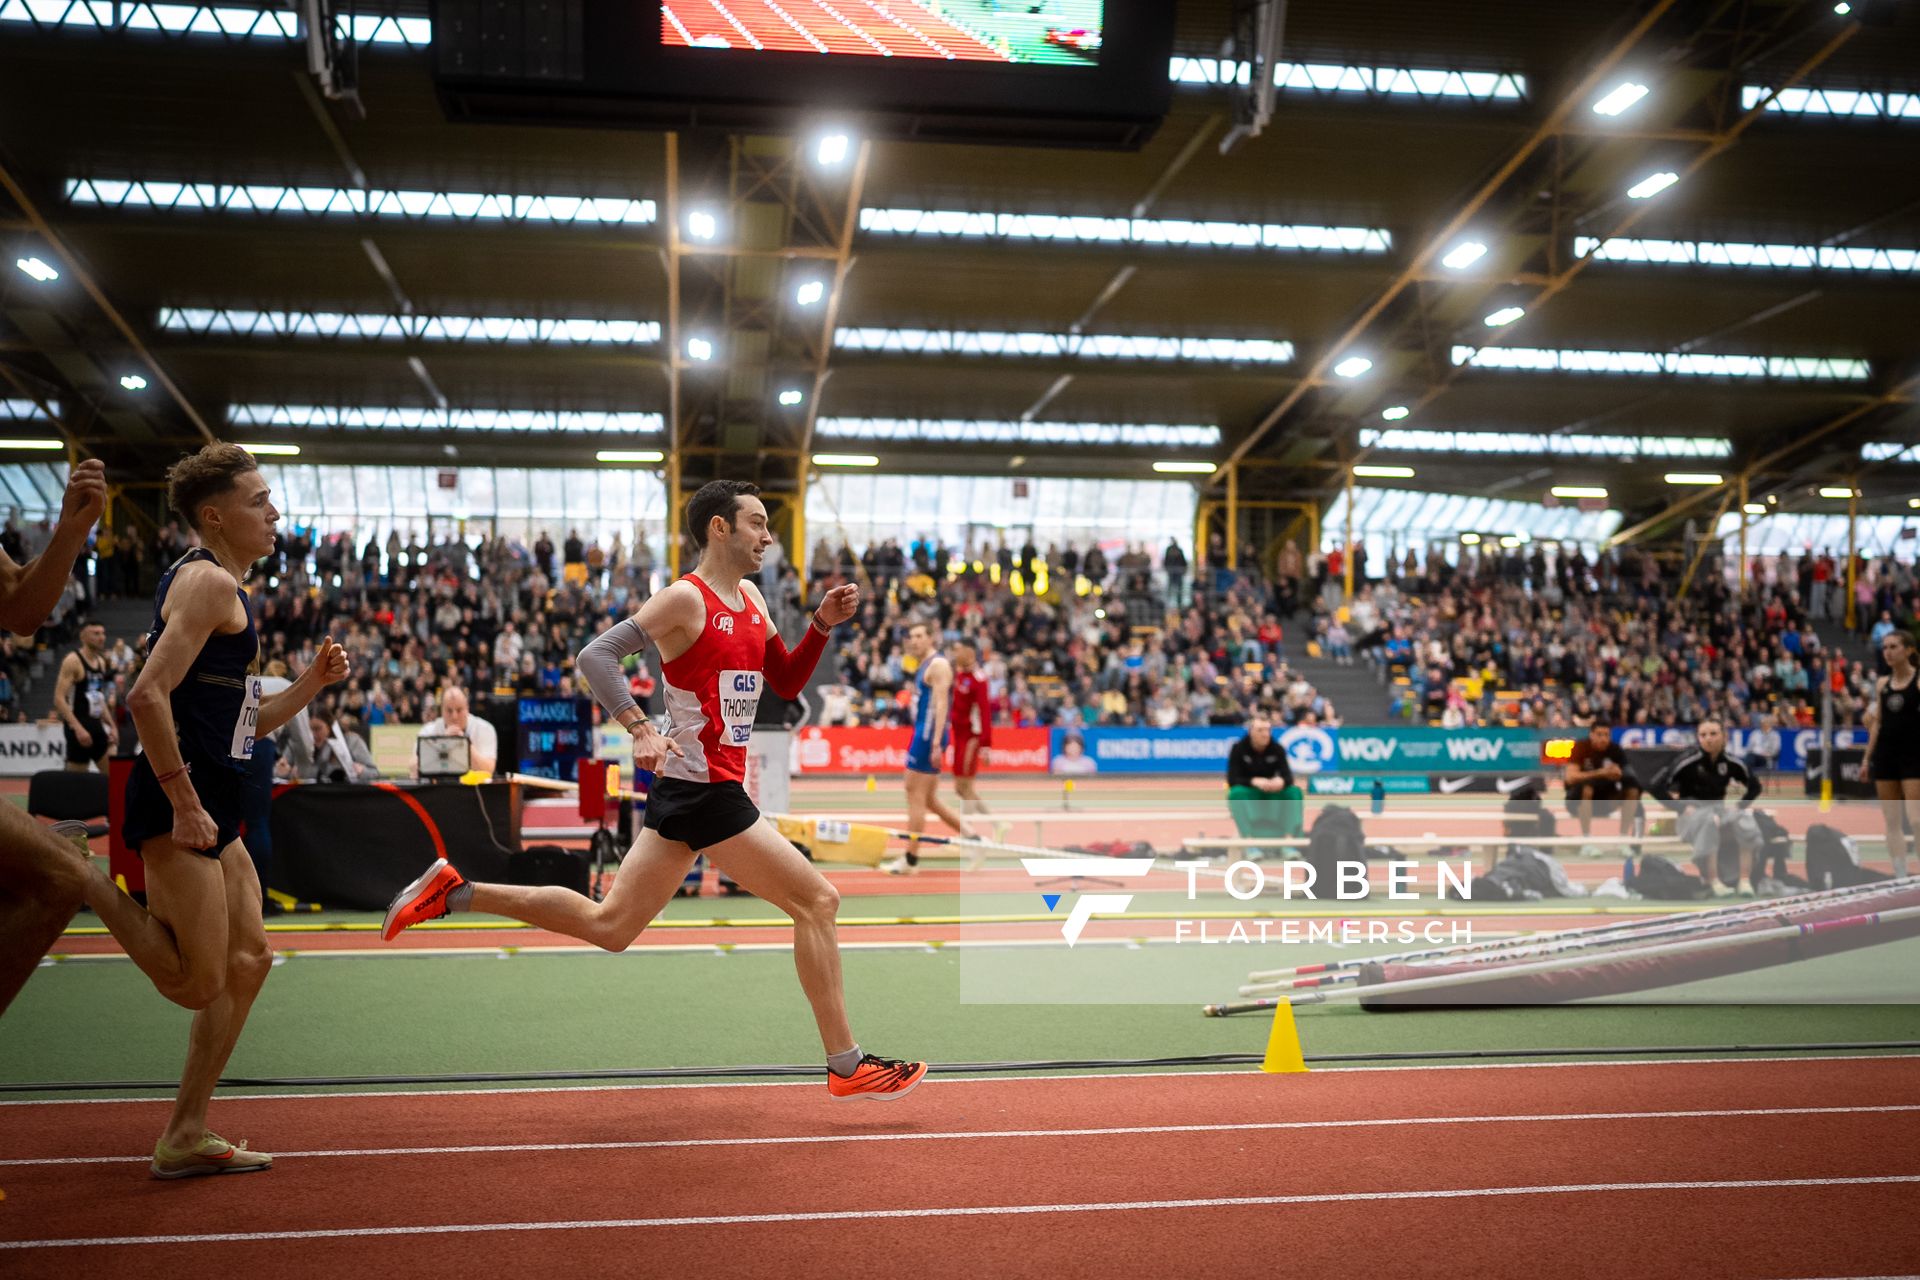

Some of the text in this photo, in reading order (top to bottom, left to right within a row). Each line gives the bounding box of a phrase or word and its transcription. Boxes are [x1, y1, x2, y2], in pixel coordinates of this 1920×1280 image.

[733, 674, 756, 692] GLS
[1338, 737, 1398, 762] WGV
[1446, 737, 1504, 762] WGV
[1311, 777, 1355, 793] WGV
